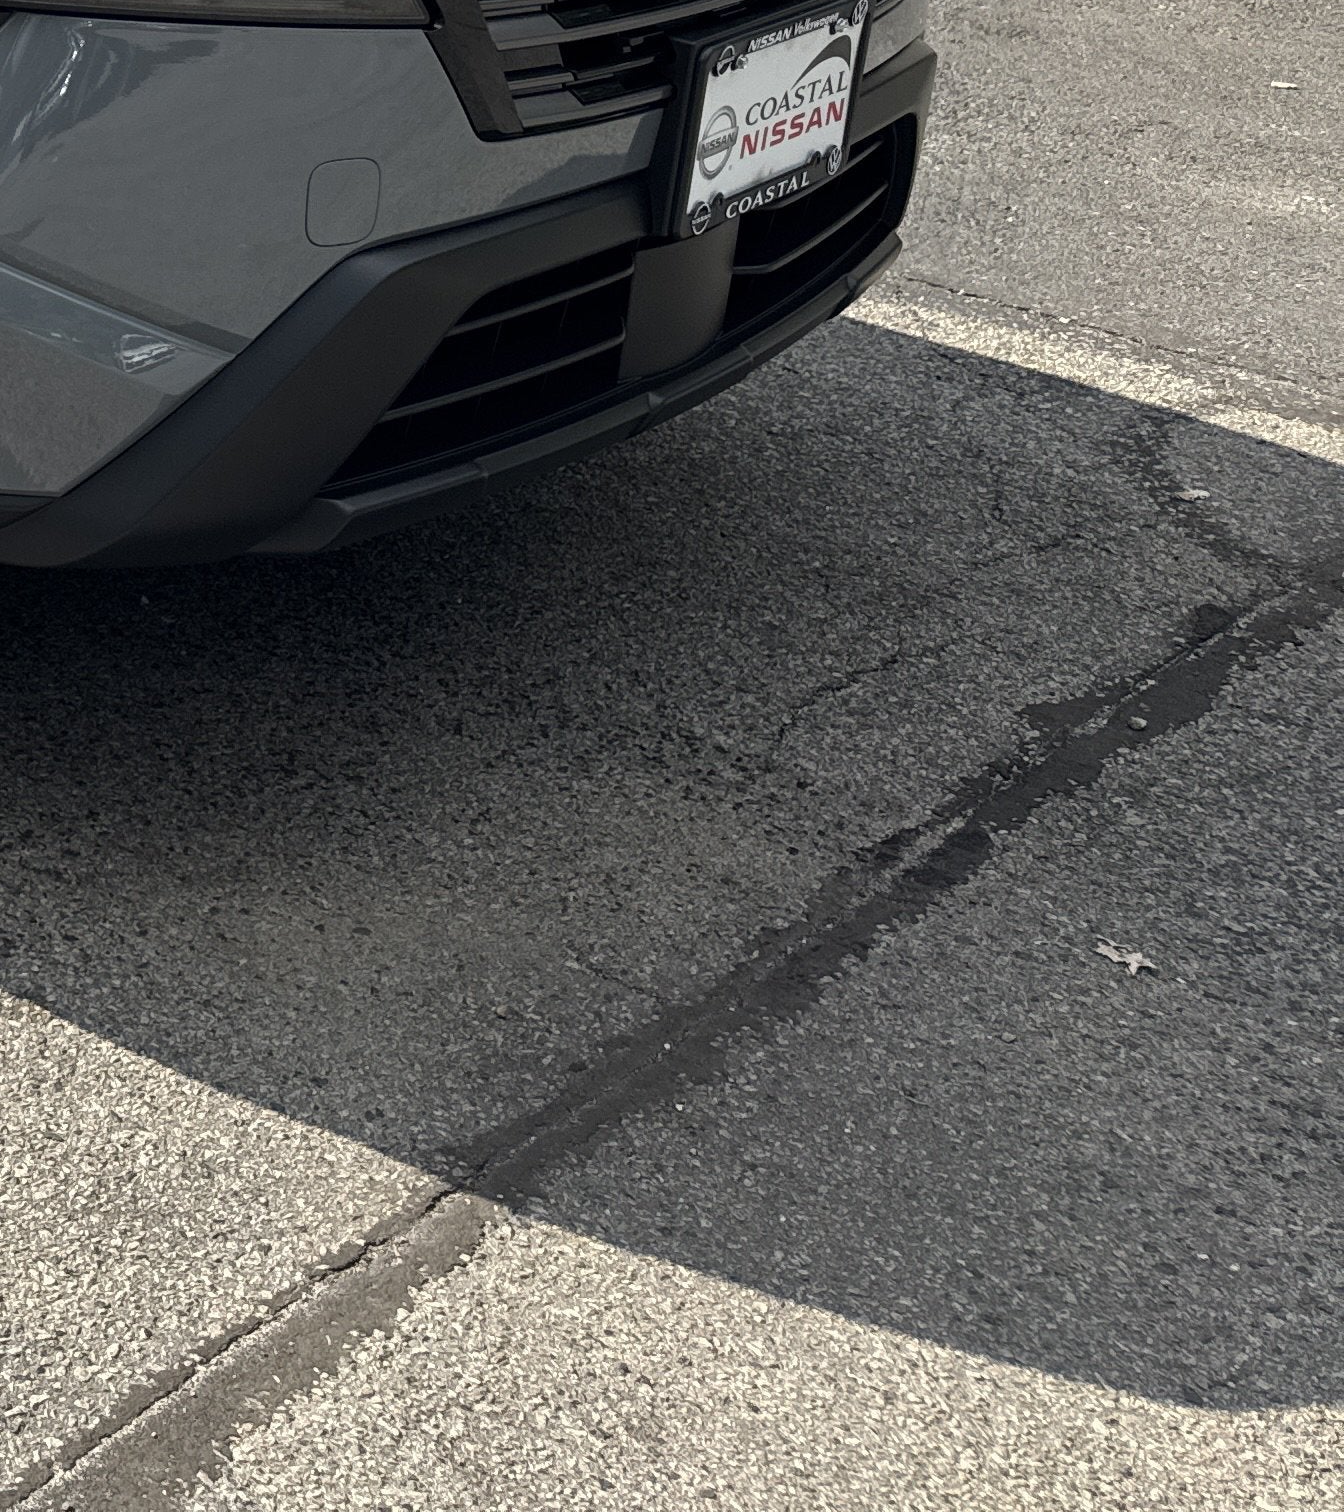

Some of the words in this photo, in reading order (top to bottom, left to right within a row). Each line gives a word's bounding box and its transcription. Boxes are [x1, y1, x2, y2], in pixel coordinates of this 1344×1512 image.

[747, 28, 792, 53] NISSAN
[745, 70, 848, 126] COASTAL
[740, 98, 845, 160] NISSAN
[725, 171, 810, 219] COASTAL
